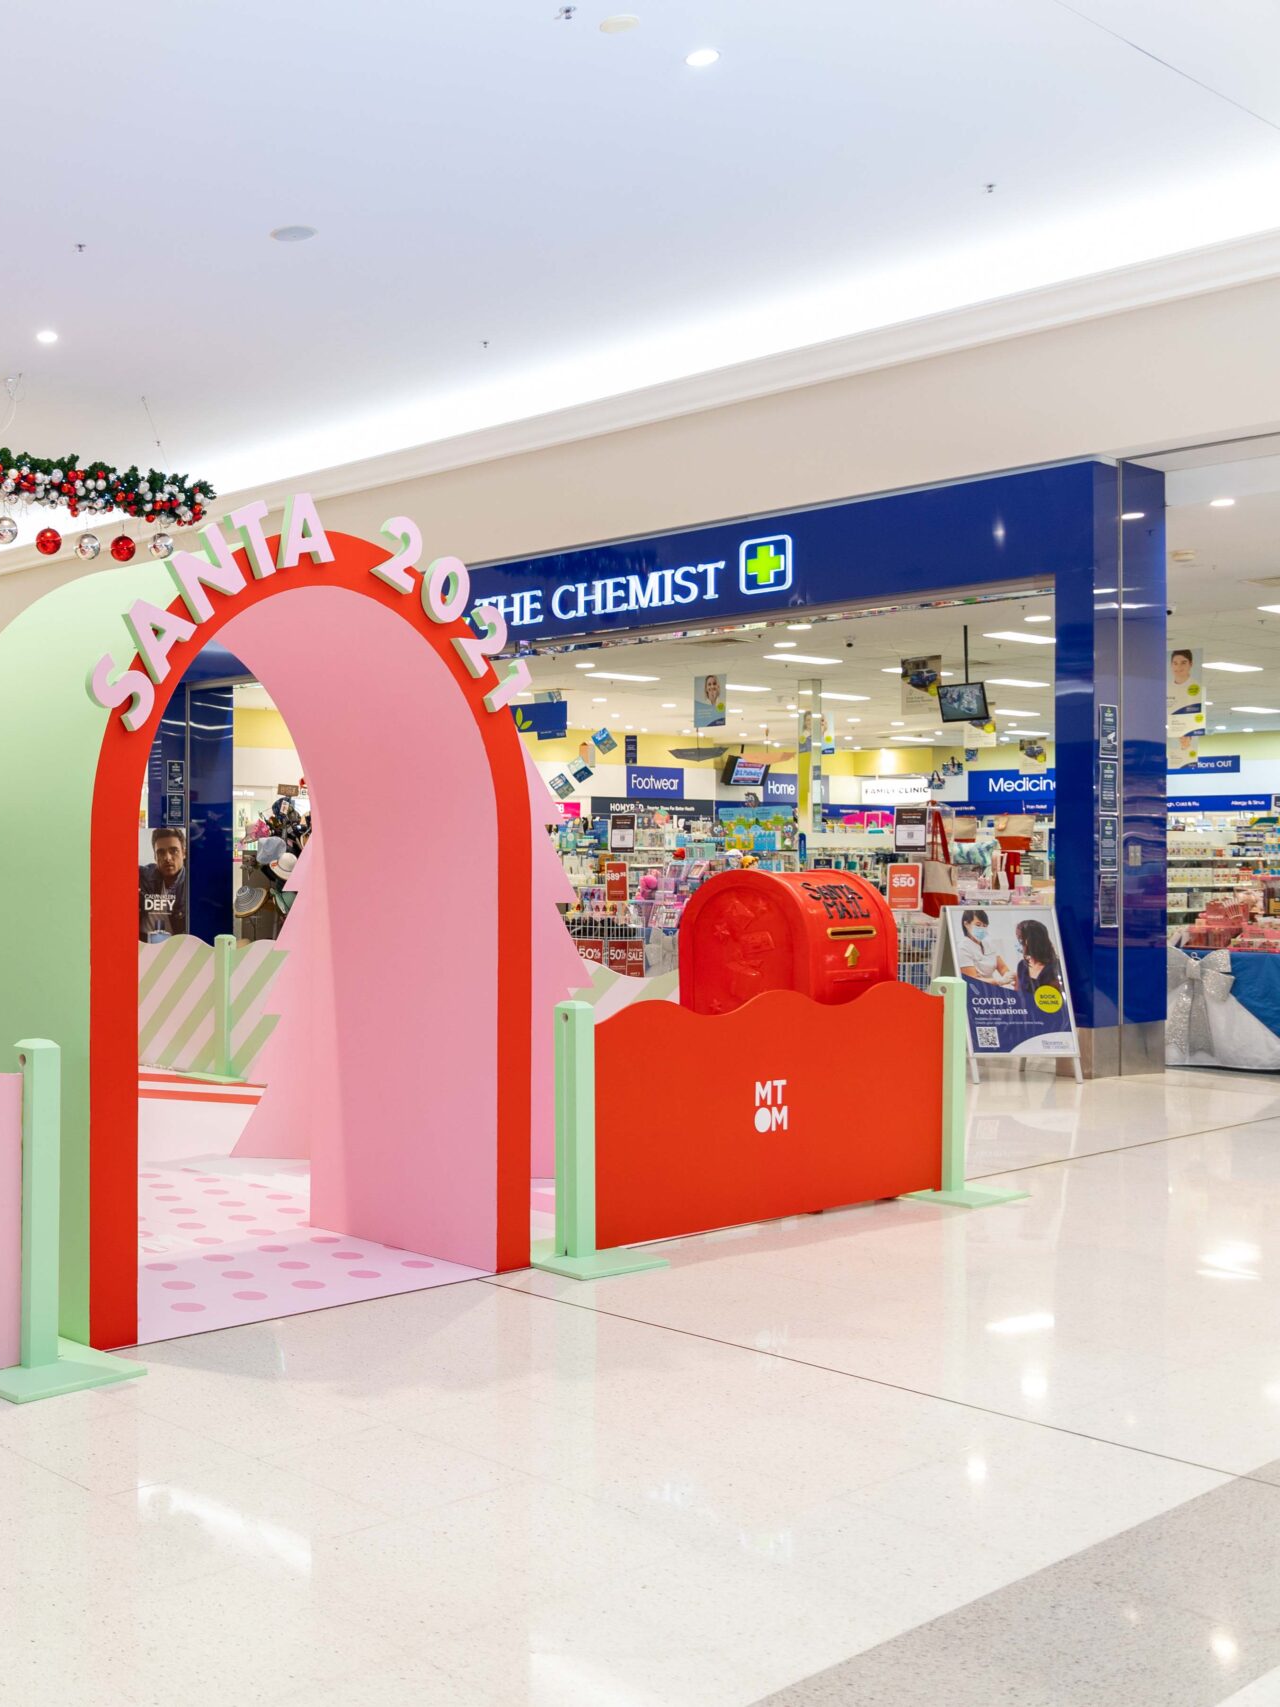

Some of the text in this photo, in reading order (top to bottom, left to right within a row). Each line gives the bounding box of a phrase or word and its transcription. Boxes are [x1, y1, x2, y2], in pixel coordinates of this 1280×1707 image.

[474, 560, 726, 630] THE CHEMIST
[85, 493, 533, 732] SANTA 2021
[1216, 760, 1232, 768] OUT
[631, 773, 679, 791] Footwear
[767, 780, 796, 796] Home
[988, 776, 1056, 793] Medicin
[899, 786, 929, 795] CLINIC
[609, 803, 645, 813] HOMYPD
[892, 877, 916, 888] $50
[801, 882, 863, 901] SANTA
[144, 900, 176, 911] DEFY
[824, 900, 870, 919] MAIL
[628, 951, 643, 961] SALE
[972, 997, 1017, 1006] COVID-19
[973, 1006, 1028, 1015] Vaccinations
[755, 1079, 787, 1107] MT
